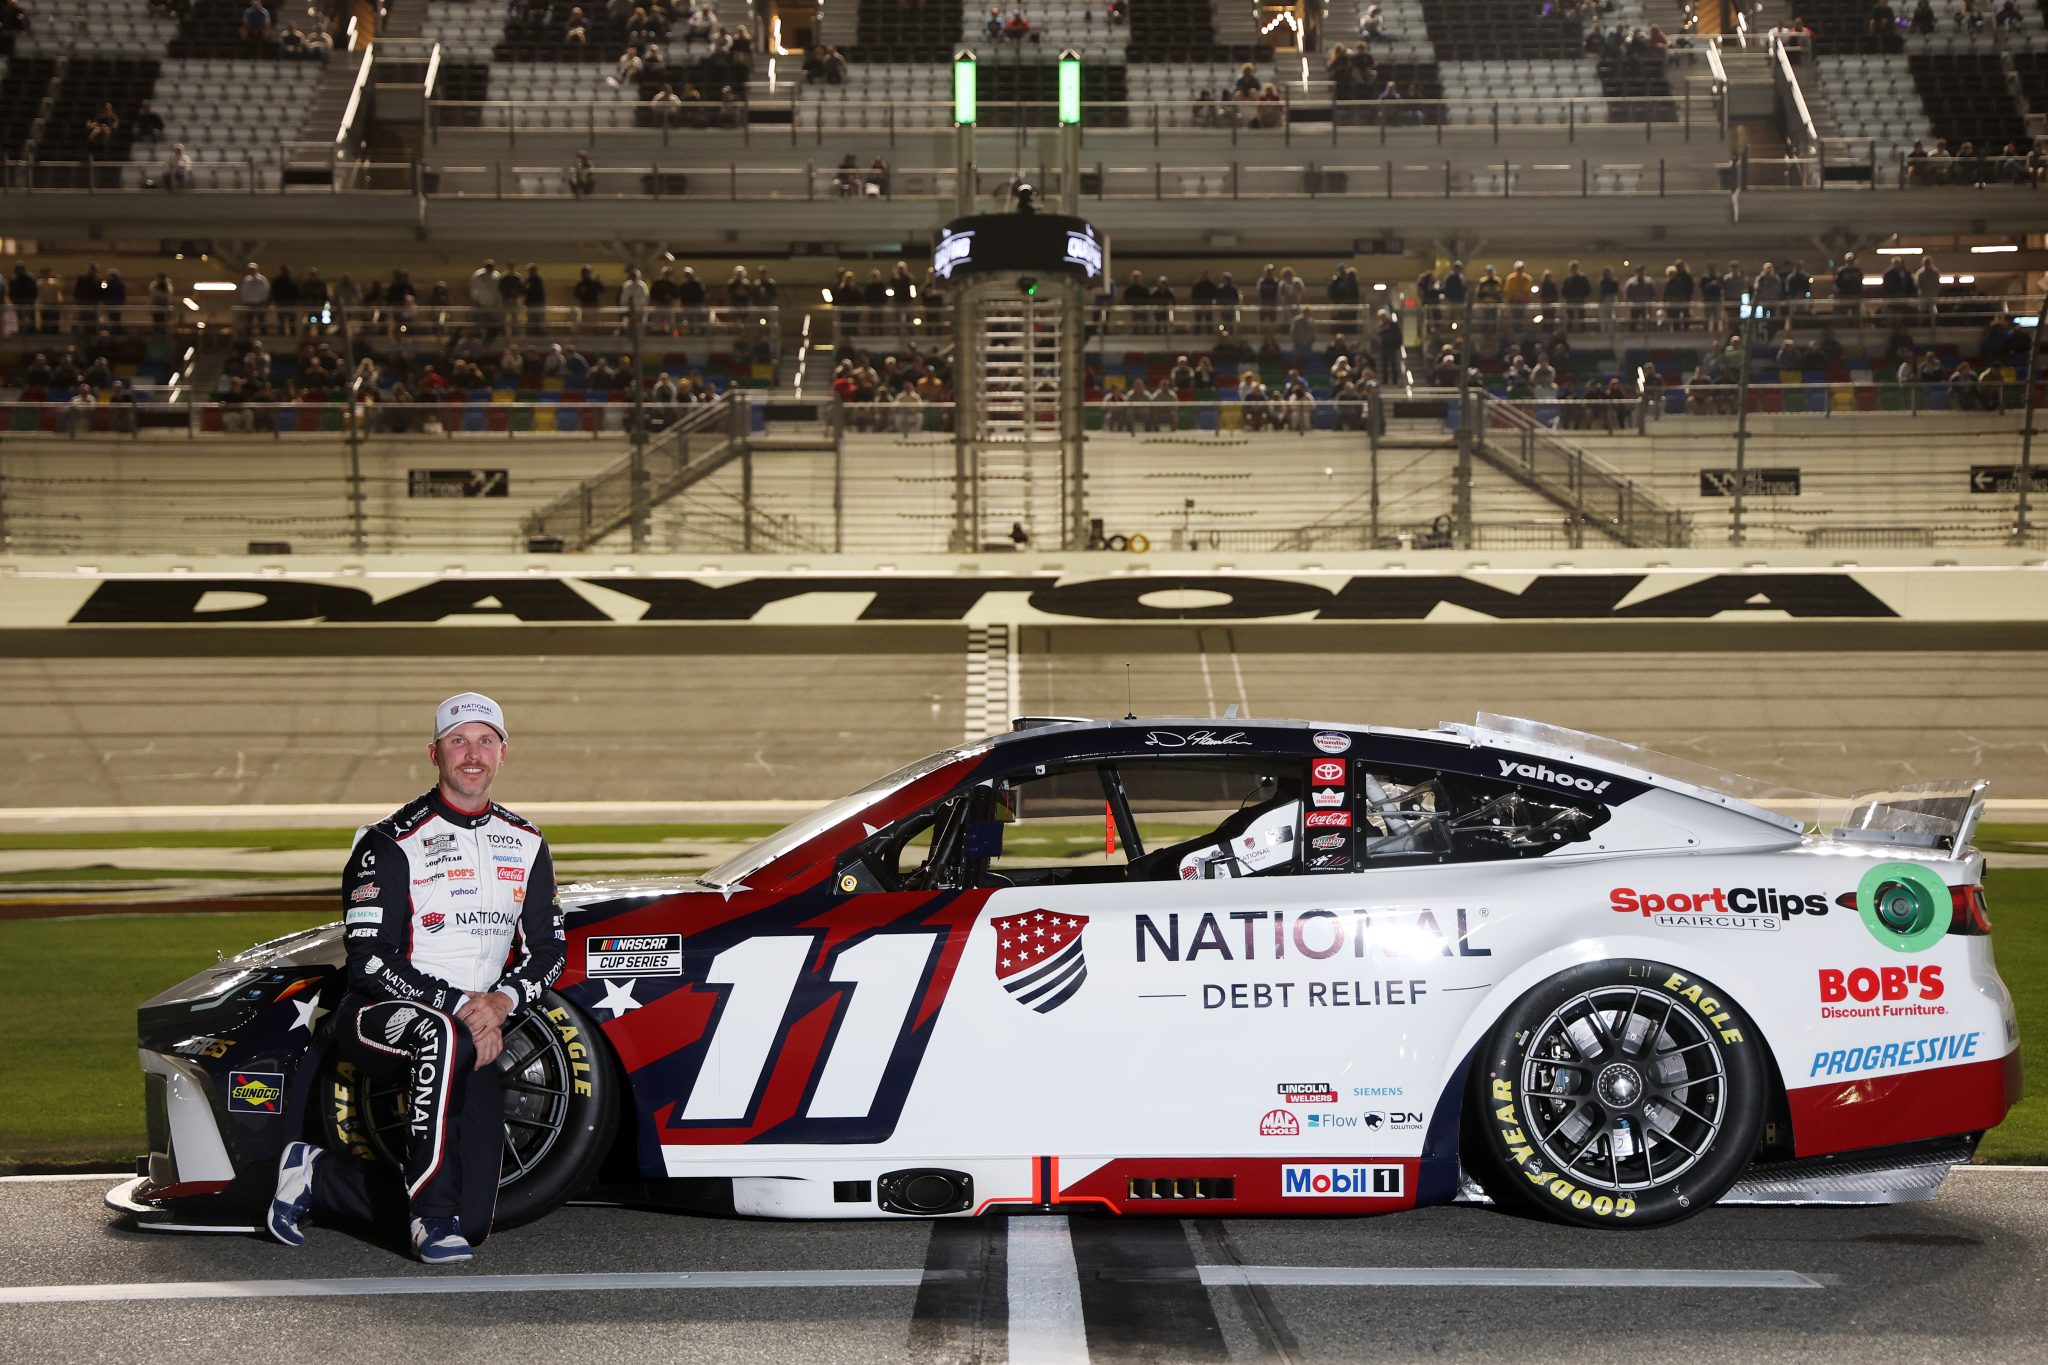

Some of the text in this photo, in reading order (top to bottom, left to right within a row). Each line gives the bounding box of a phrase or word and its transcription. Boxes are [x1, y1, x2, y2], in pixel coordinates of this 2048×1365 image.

[68, 574, 1903, 624] DAYTONA
[461, 703, 494, 714] NATIONAL
[1498, 759, 1611, 794] yahoo!
[486, 834, 523, 847] TOYOA
[1243, 849, 1270, 862] ATIONAL
[447, 869, 475, 878] BOB'S
[450, 888, 479, 898] yahoo!
[1609, 887, 1829, 921] SportClips
[1660, 916, 1776, 929] HAIRCUTS
[348, 927, 379, 939] JGR
[617, 937, 668, 951] NASCAR
[600, 955, 669, 969] CUP SERIES
[1818, 965, 1945, 1003] BOB'S
[1203, 979, 1427, 1009] DEBT RELIEF
[1663, 973, 1744, 1045] EAGLE
[1821, 1006, 1881, 1019] Discount
[681, 932, 938, 1120] 11
[547, 1006, 592, 1097] EAGLE
[1810, 1032, 1980, 1077] PROGRESSIVE
[411, 1018, 438, 1136] NATIONAL
[233, 1085, 279, 1099] SUNOCO
[1279, 1084, 1327, 1094] LINCOLN
[1353, 1087, 1403, 1096] SIEMENS
[1264, 1110, 1296, 1128] MAC
[1322, 1113, 1357, 1127] Flow
[1389, 1112, 1423, 1123] DN
[1261, 1127, 1298, 1135] TOOLS
[1286, 1168, 1366, 1193] Mobil
